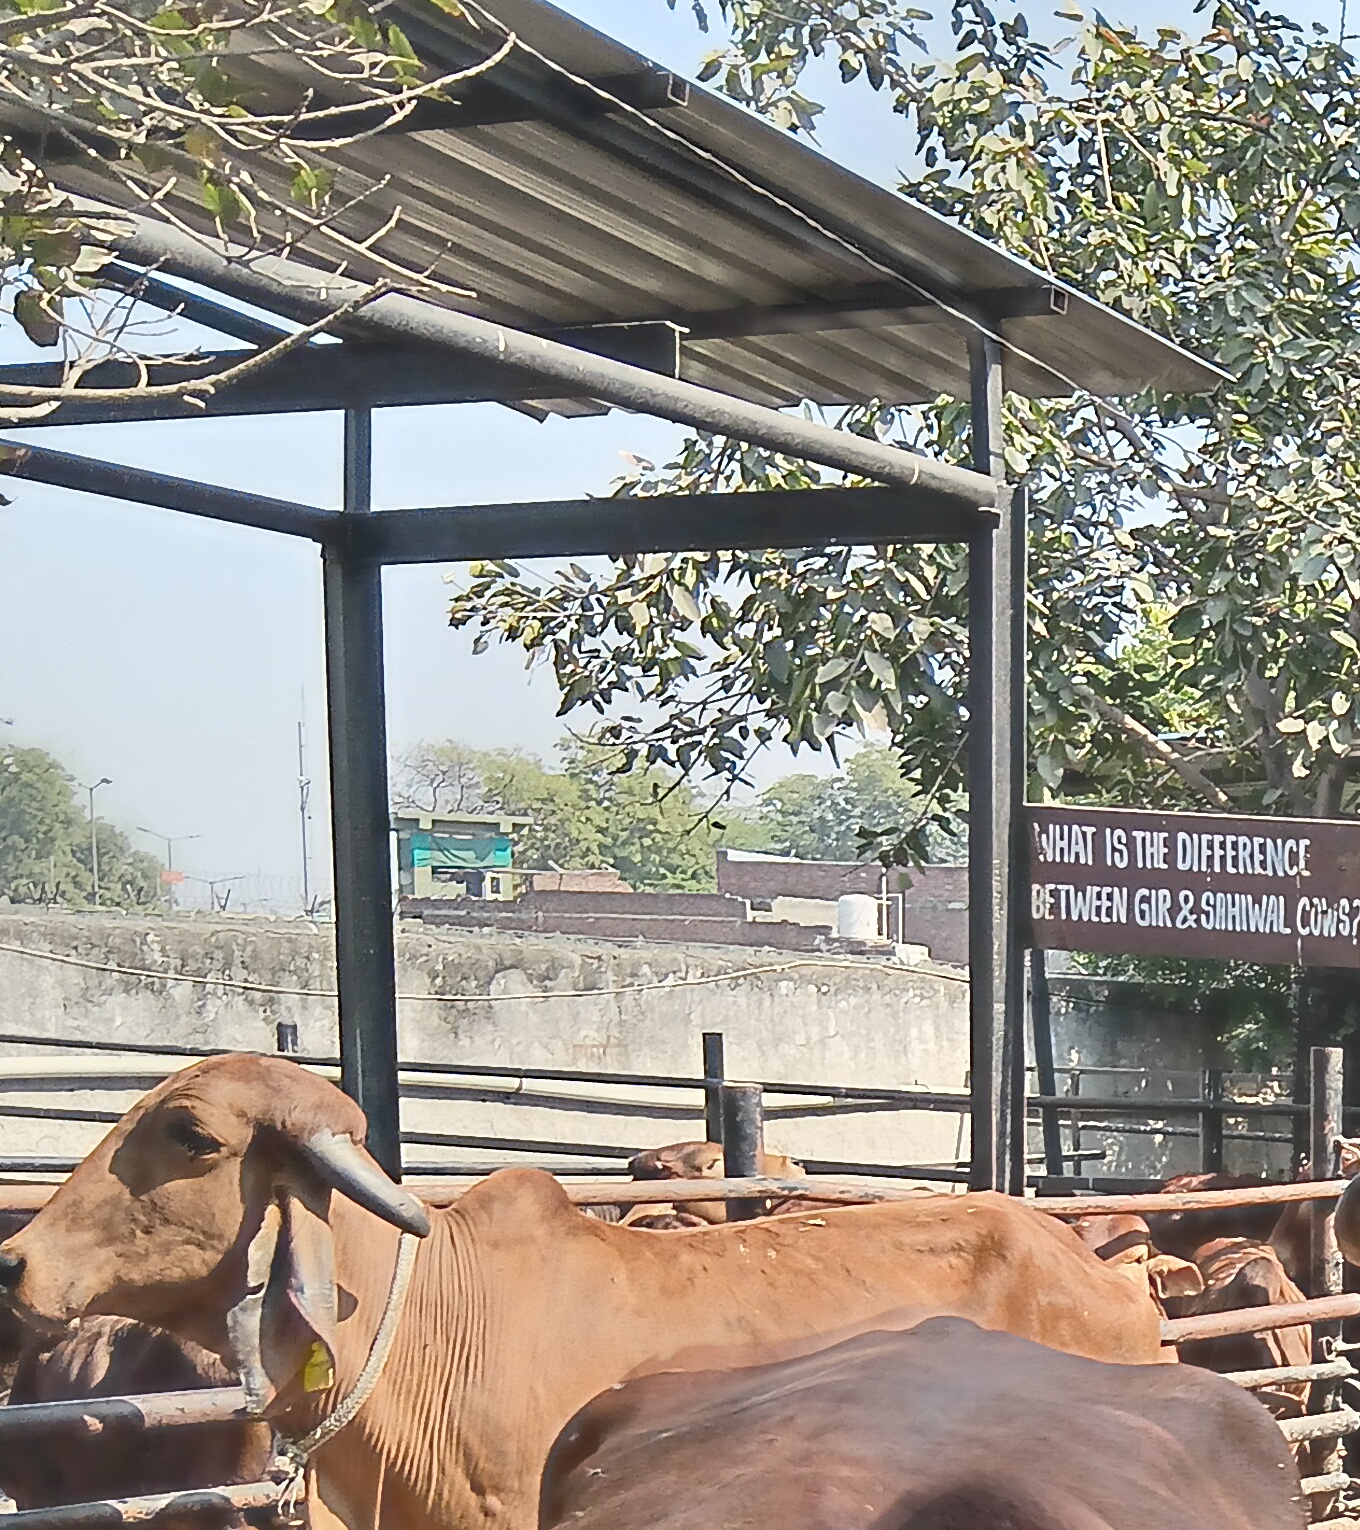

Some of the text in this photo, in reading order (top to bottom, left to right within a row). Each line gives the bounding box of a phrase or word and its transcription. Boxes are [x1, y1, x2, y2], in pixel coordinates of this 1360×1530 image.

[1033, 822, 1312, 877] WHAT IS THE DIFFERENCE
[1031, 883, 1128, 924] BETWEEN
[1134, 887, 1173, 928] GIR
[1175, 889, 1198, 930] &
[1200, 891, 1292, 935] SAHIWAL
